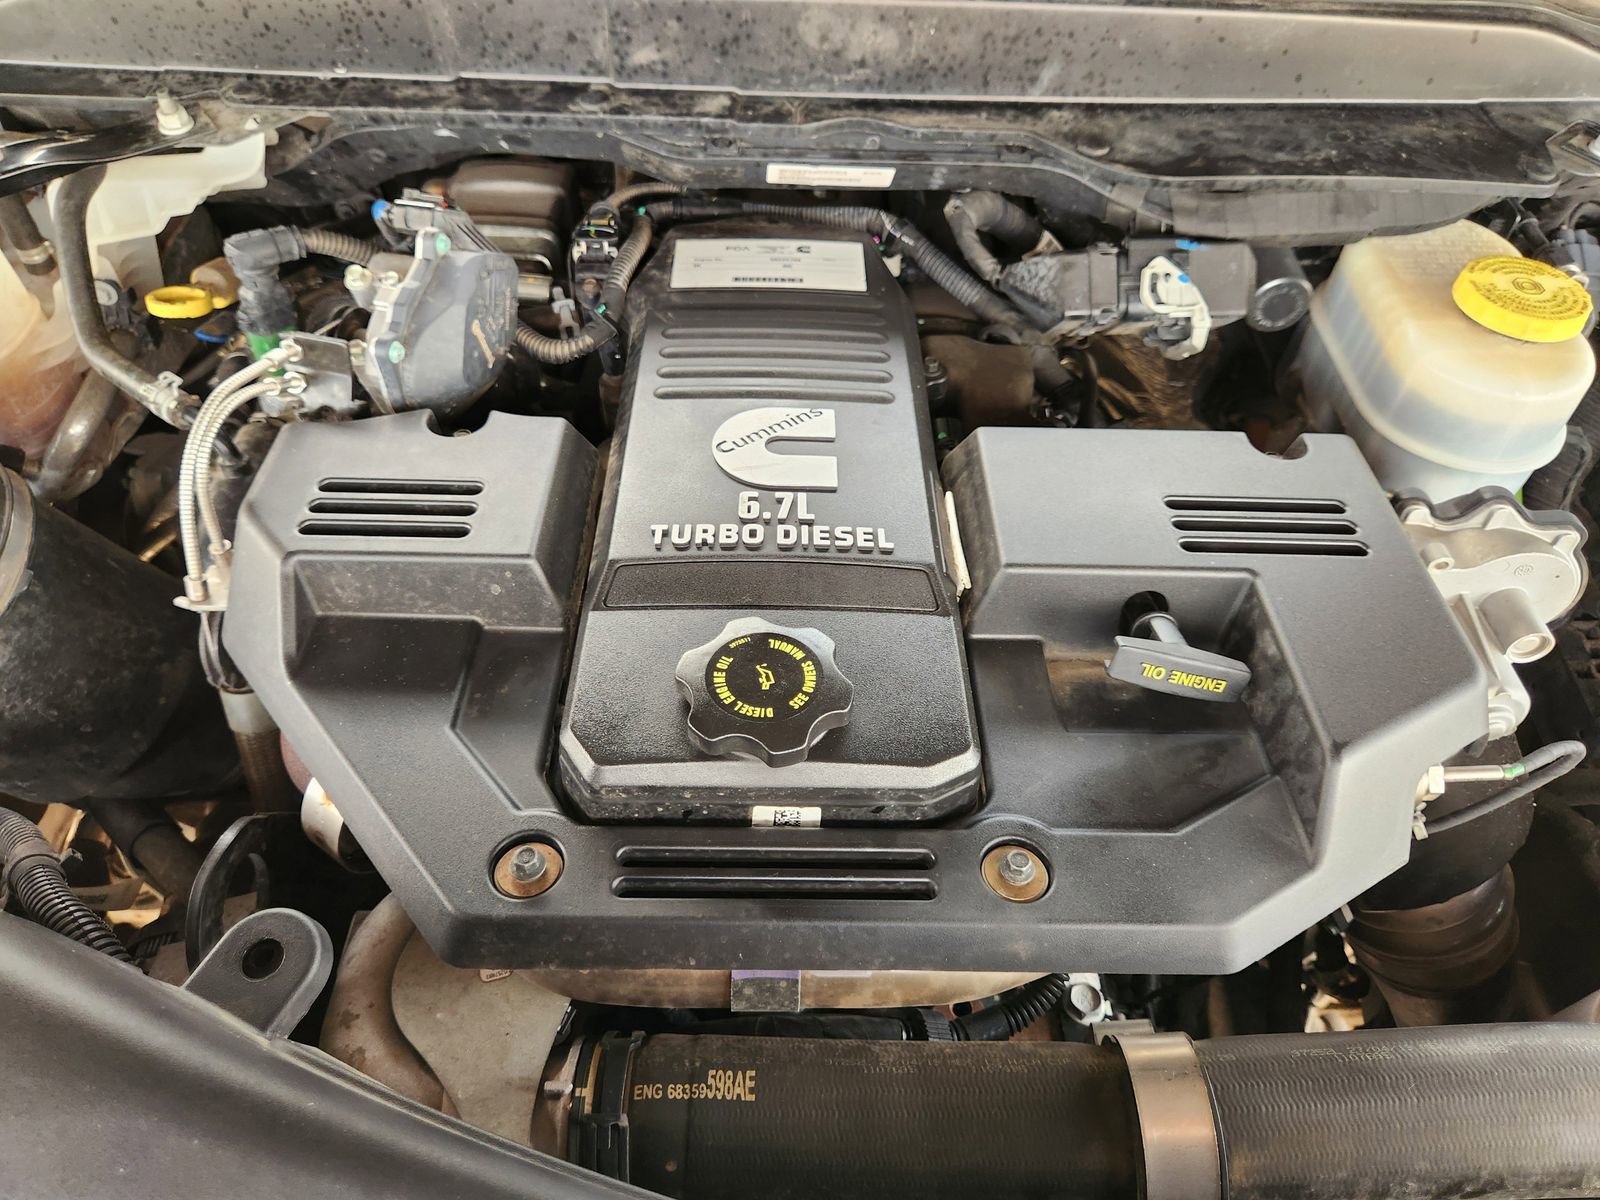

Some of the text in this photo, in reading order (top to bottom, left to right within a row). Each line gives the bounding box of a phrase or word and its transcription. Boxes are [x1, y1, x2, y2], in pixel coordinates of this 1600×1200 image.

[715, 408, 823, 453] Cummins
[738, 491, 815, 523] 6.7L
[651, 523, 895, 554] TURBO DIESEL
[714, 655, 773, 717] DIESEL ENGINE OIL
[769, 639, 816, 709] SEE OWNERS MANUAL
[1141, 663, 1227, 692] ENGINE OIL
[633, 1084, 662, 1100] ENG
